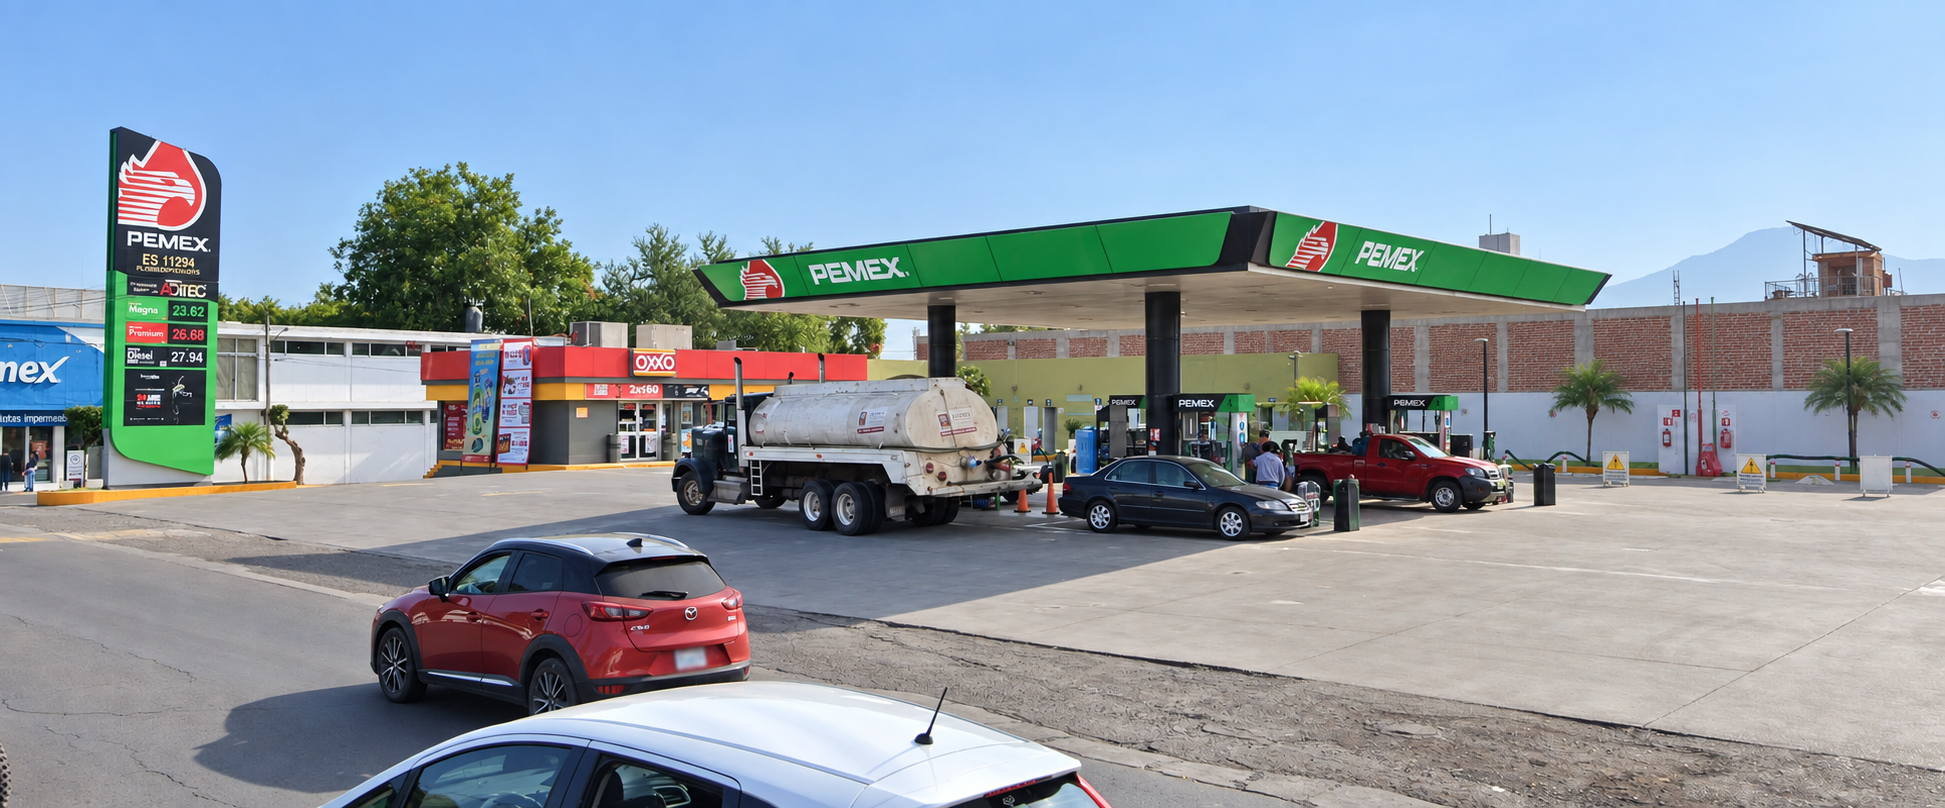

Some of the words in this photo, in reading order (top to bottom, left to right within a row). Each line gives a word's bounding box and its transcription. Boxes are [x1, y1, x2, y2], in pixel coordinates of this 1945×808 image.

[127, 230, 210, 252] PEMEX
[142, 253, 159, 266] ES
[162, 255, 195, 268] 11294
[1354, 240, 1425, 273] PEMEX
[808, 257, 910, 285] PEMEX
[128, 305, 158, 316] Magna
[172, 305, 205, 317] 23.62
[128, 328, 164, 338] Premium
[172, 328, 205, 340] 26.68
[127, 350, 153, 360] Diesel
[171, 351, 203, 363] 27.94
[635, 354, 675, 371] OXXO
[1178, 399, 1215, 408] PEMEX
[1393, 399, 1426, 407] PEMEX
